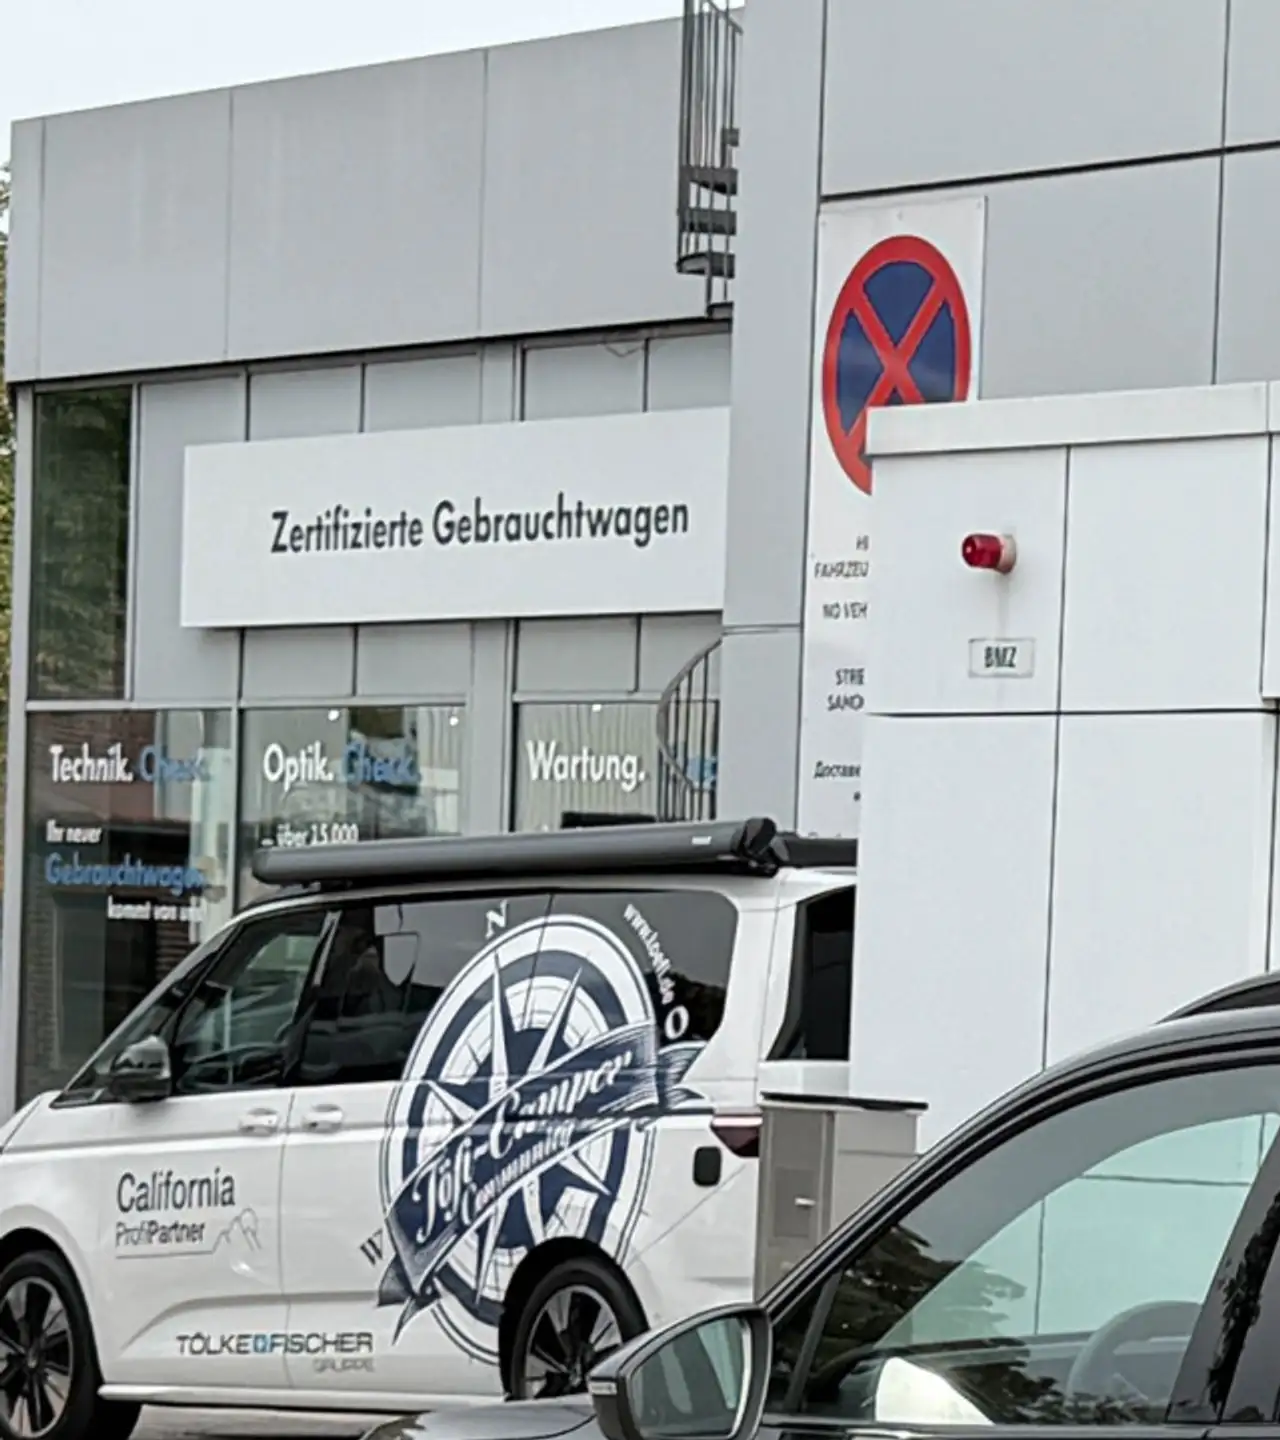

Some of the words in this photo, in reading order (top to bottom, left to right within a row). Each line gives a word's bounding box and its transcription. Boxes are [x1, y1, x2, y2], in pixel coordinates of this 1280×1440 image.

[270, 504, 424, 553] Zertifizierte
[432, 491, 689, 548] Gebrauchtwagen
[983, 645, 1017, 668] BMZ
[49, 742, 134, 783] Technik.
[263, 740, 335, 793] Optik.
[526, 739, 646, 793] Wartung.
[485, 900, 508, 939] N
[116, 1166, 236, 1214] California
